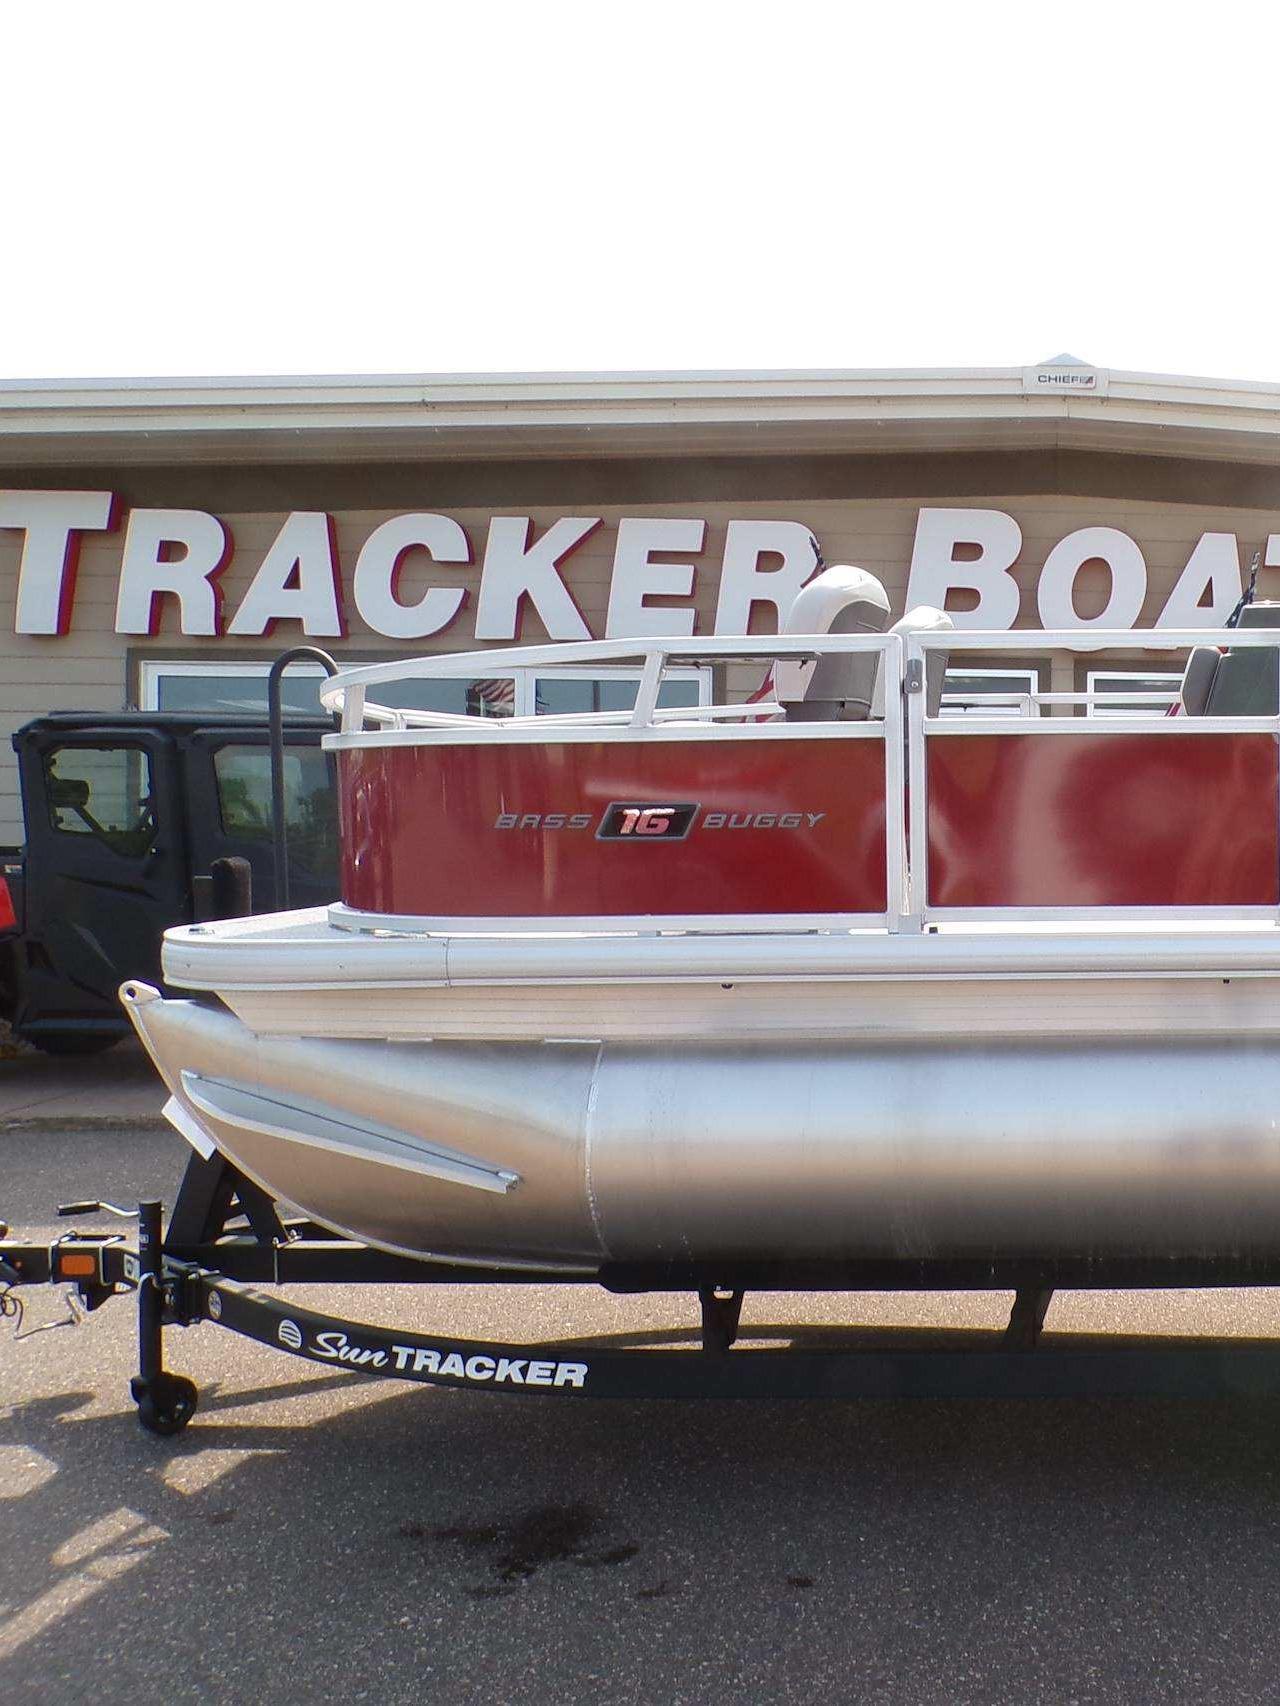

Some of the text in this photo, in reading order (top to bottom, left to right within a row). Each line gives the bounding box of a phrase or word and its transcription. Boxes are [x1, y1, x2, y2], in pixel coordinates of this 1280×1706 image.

[1037, 374, 1079, 384] CHIEF
[0, 489, 822, 642] TRACKER
[494, 808, 826, 834] BASS 16 BUGGY
[309, 1332, 589, 1388] Sun TRACKER
